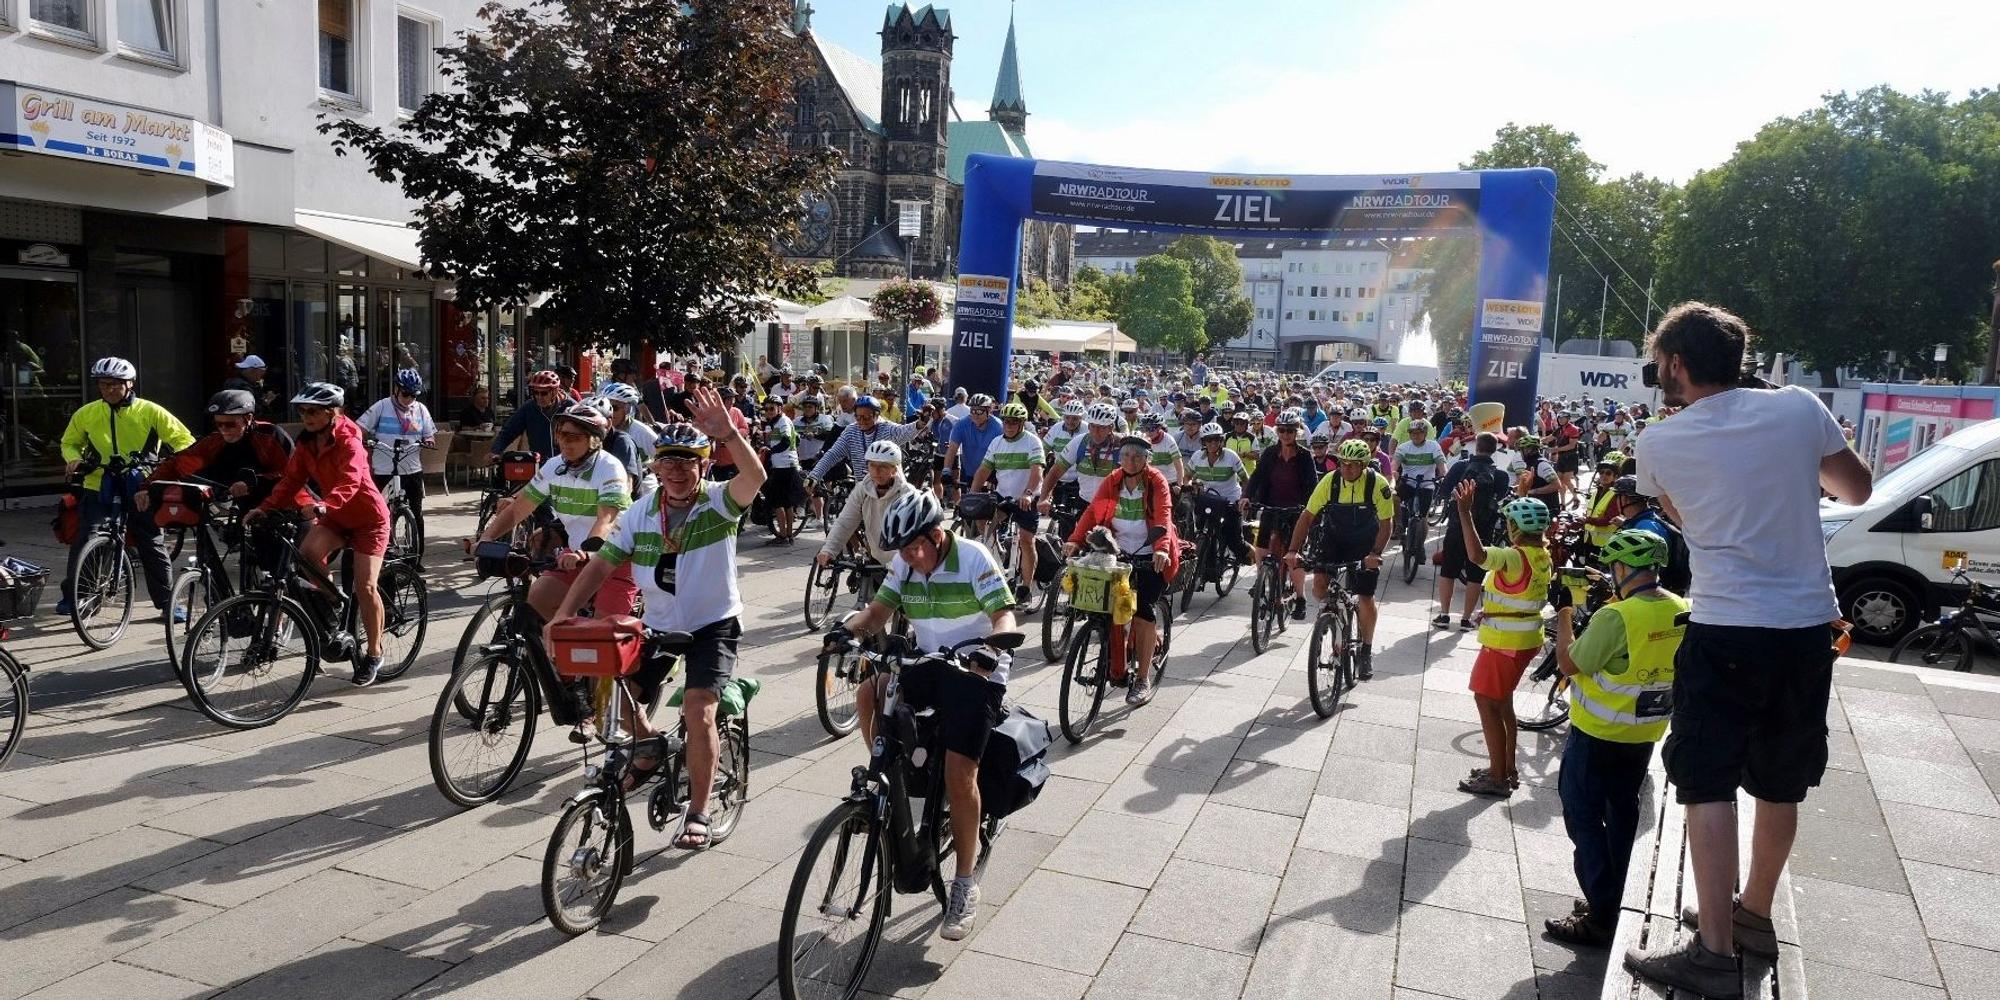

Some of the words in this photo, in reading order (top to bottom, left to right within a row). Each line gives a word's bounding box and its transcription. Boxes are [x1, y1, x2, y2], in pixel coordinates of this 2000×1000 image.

[21, 94, 74, 121] Grill
[81, 109, 116, 129] am
[122, 112, 191, 141] Markt
[87, 131, 108, 142] Seit
[111, 135, 136, 146] 1972
[86, 146, 100, 156] M.
[103, 149, 139, 161] BORAS
[1212, 176, 1243, 186] WEST
[1254, 178, 1290, 187] LOTTO
[1059, 183, 1148, 200] NRWRADTOUR
[1214, 194, 1281, 222] ZIEL
[1352, 194, 1450, 208] NRWRADTOUR
[983, 291, 1000, 300] WDR
[960, 331, 993, 349] ZIEL
[1487, 360, 1527, 380] ZIEL
[1580, 371, 1628, 389] WDR
[1944, 551, 1967, 559] ADAC
